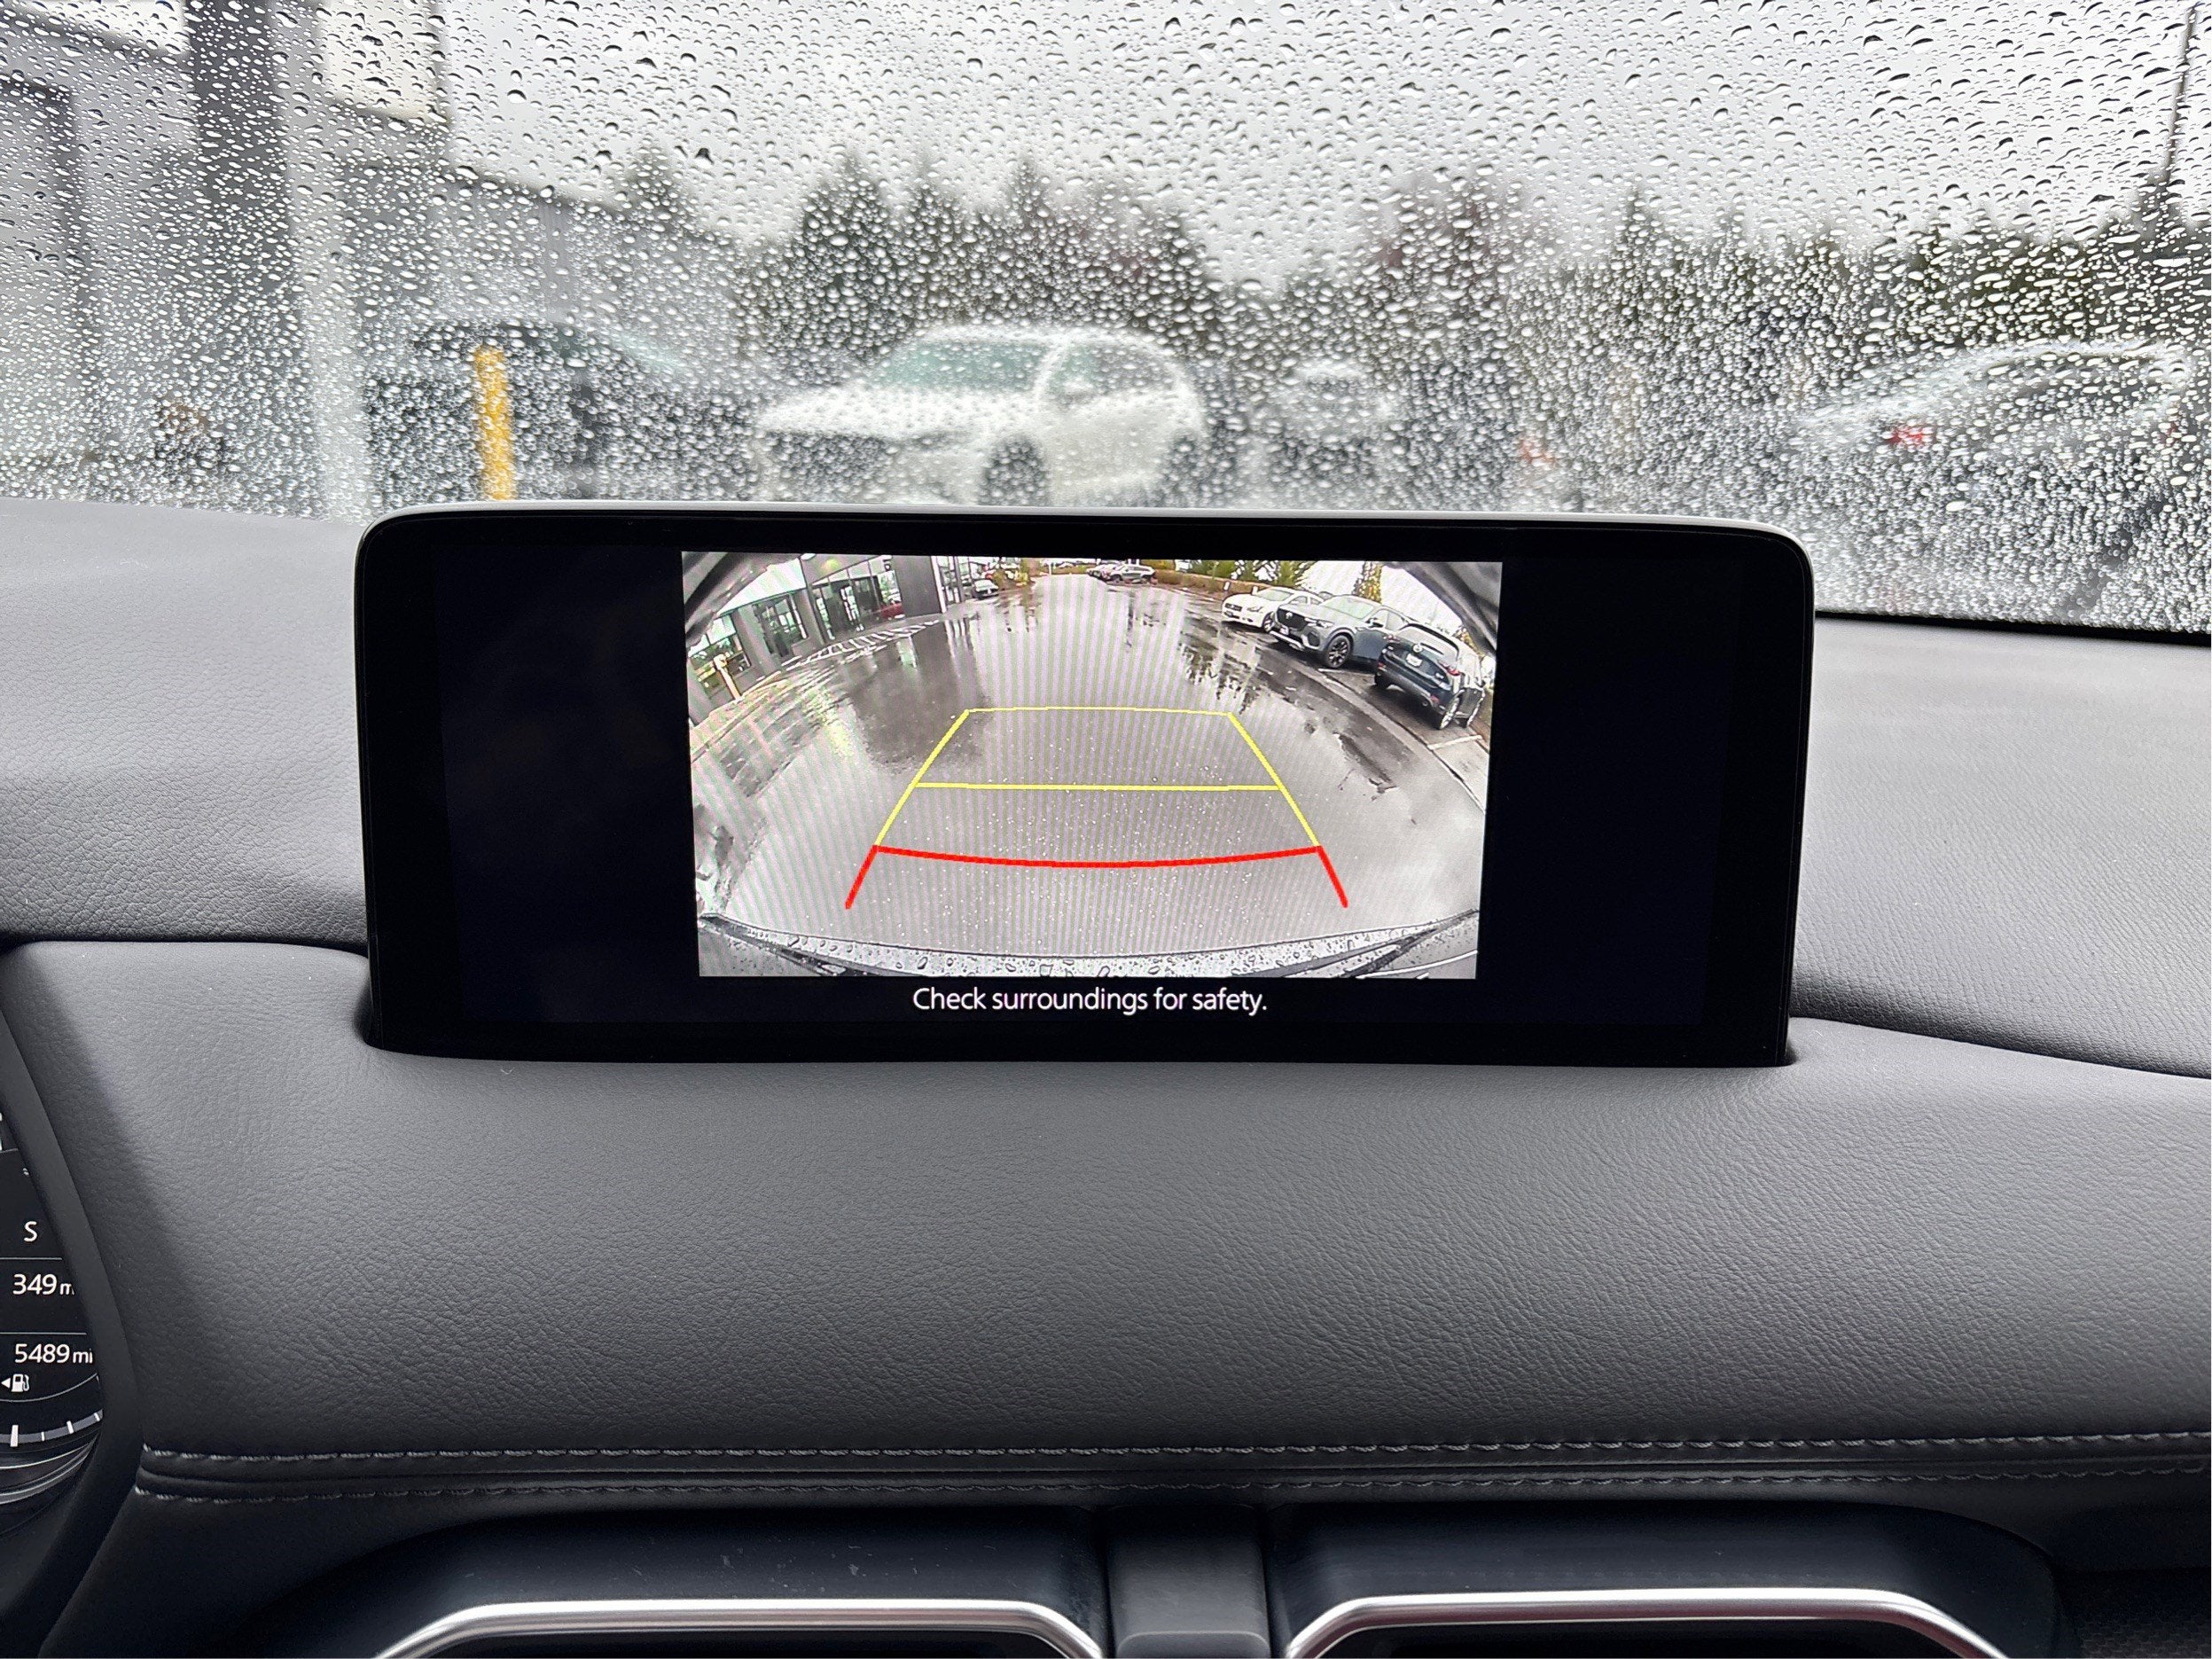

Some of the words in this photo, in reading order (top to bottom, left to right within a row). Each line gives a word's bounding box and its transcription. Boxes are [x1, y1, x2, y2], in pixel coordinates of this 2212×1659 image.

[912, 986, 987, 1010] Check
[991, 986, 1149, 1016] surroundings
[1153, 986, 1188, 1011] for
[1192, 986, 1267, 1017] safety.
[23, 1220, 38, 1242] S
